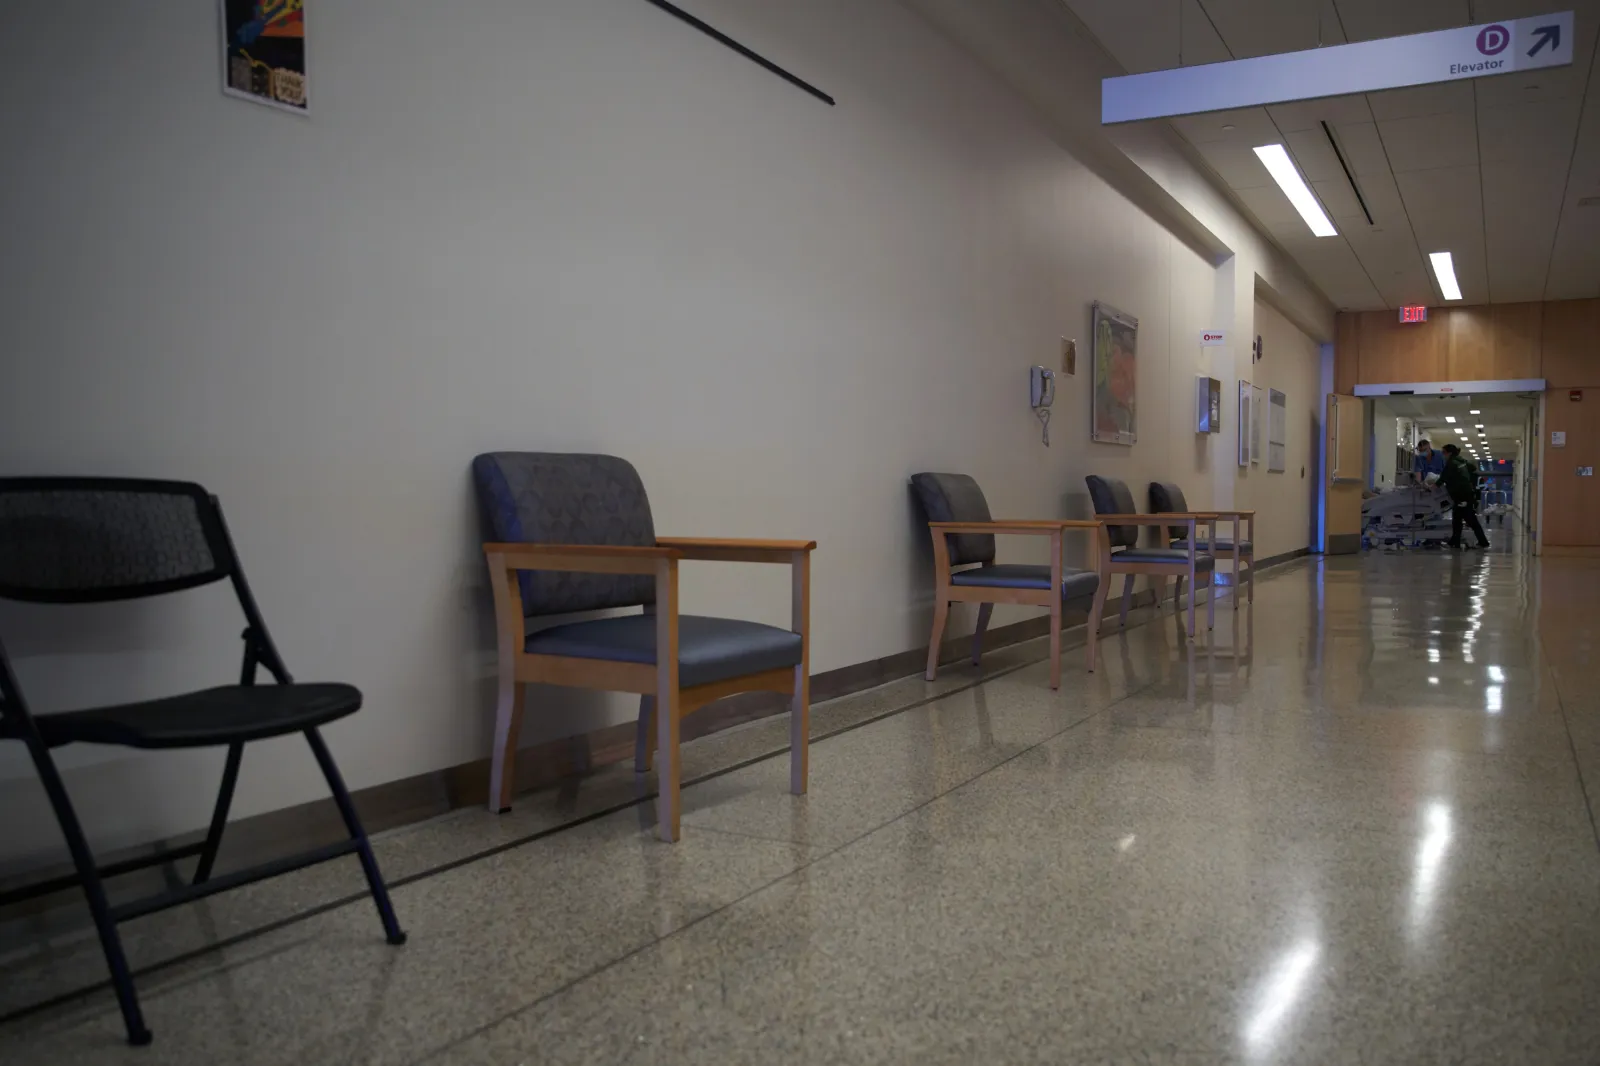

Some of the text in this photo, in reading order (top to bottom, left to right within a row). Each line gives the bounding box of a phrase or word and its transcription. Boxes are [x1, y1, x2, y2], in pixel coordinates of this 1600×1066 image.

[1484, 30, 1504, 51] D
[1449, 59, 1504, 75] Elevator
[1404, 306, 1425, 321] EXIT
